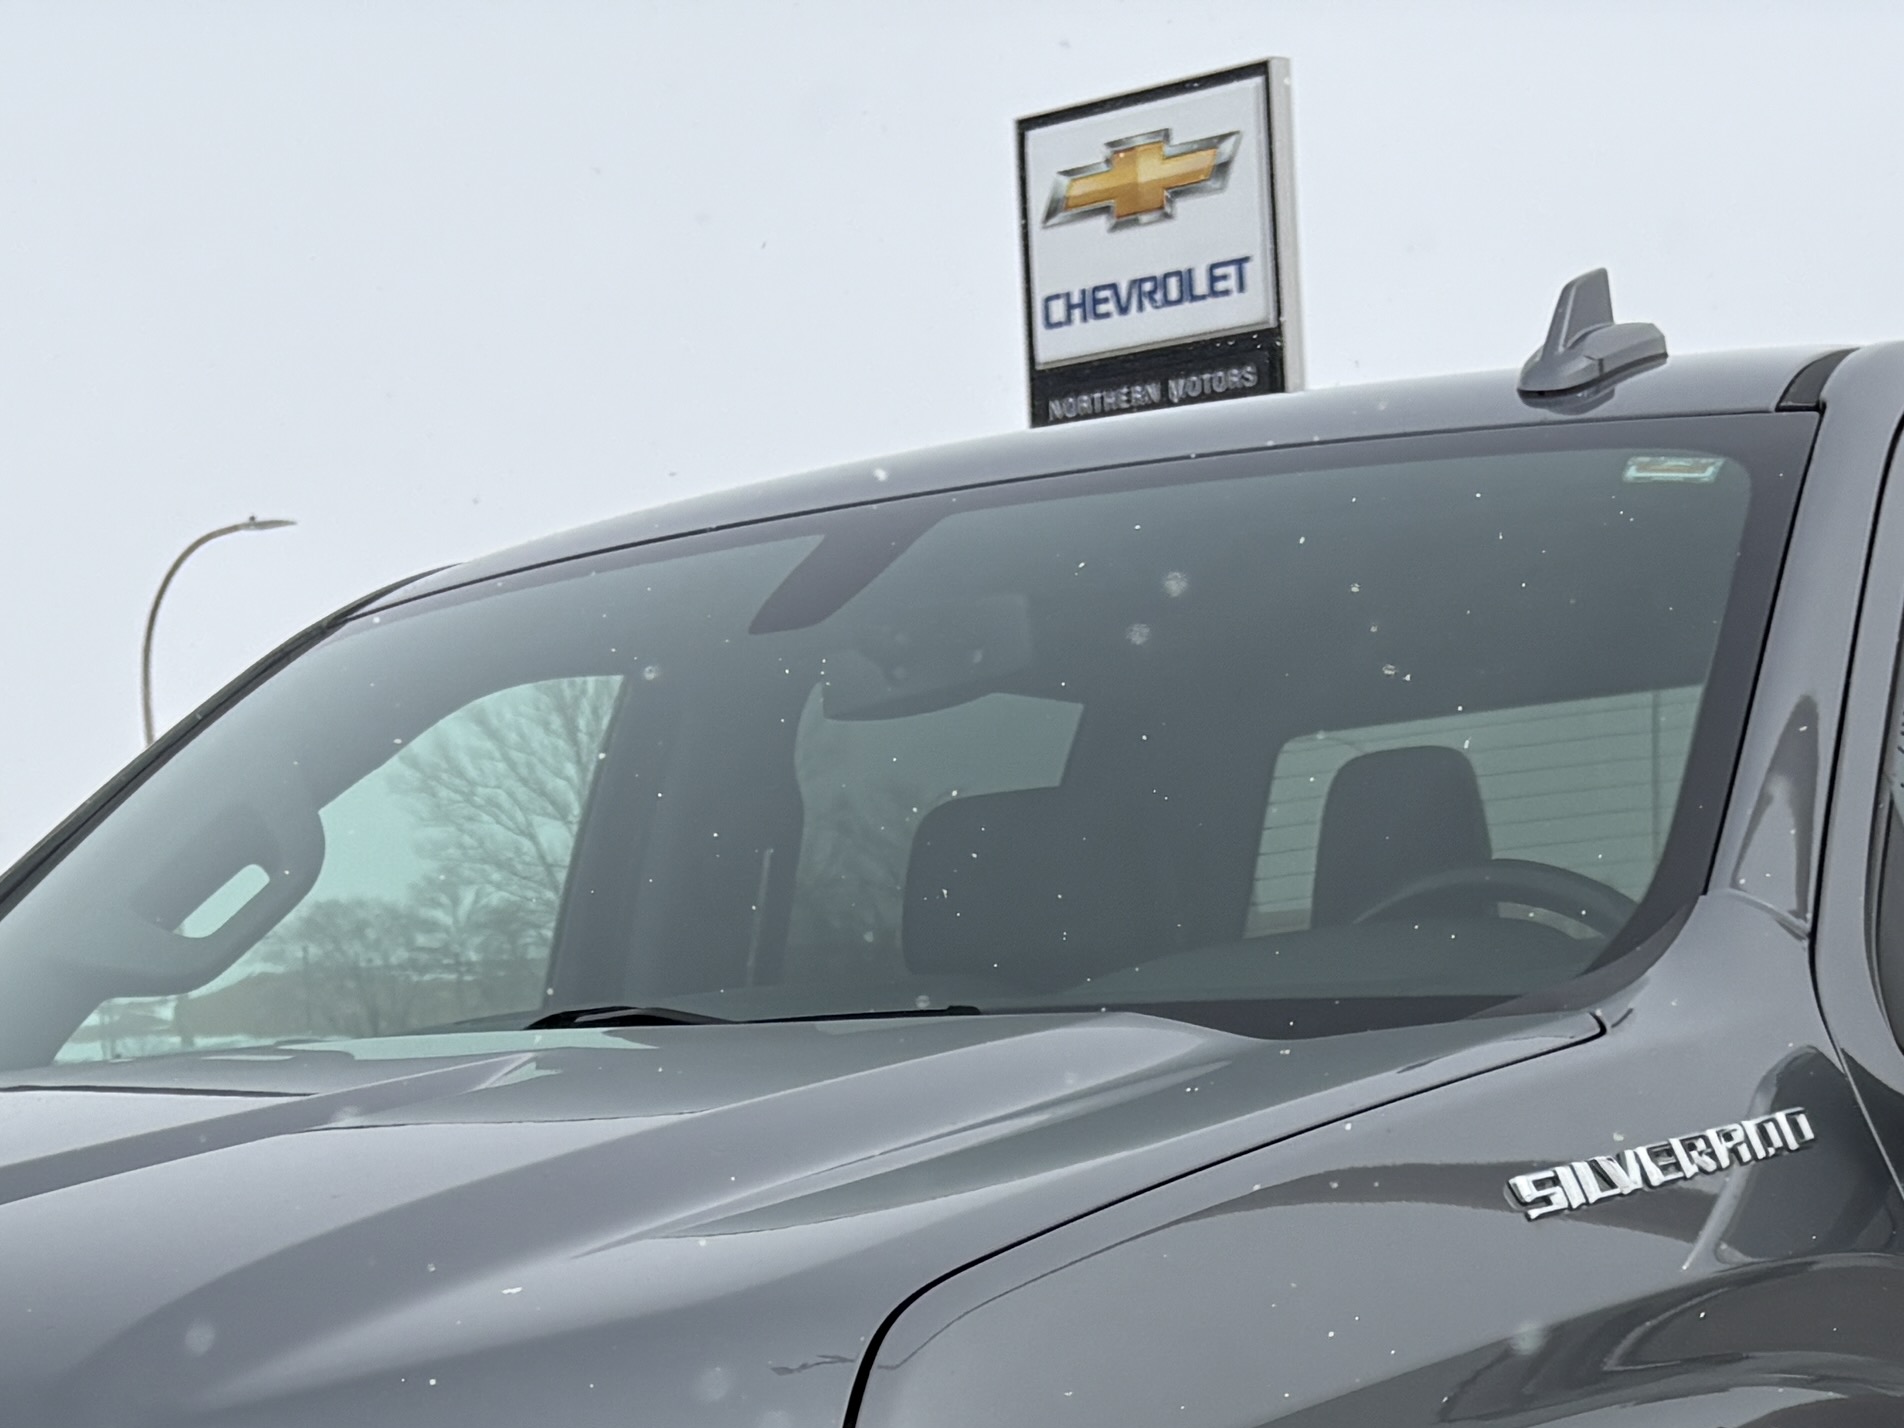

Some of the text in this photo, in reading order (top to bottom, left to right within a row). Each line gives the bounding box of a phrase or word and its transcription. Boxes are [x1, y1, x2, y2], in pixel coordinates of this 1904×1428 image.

[1043, 255, 1253, 330] CHEVROLET
[1048, 363, 1258, 421] NORTHERN MOTORS
[1505, 1106, 1816, 1222] SILVERADO
